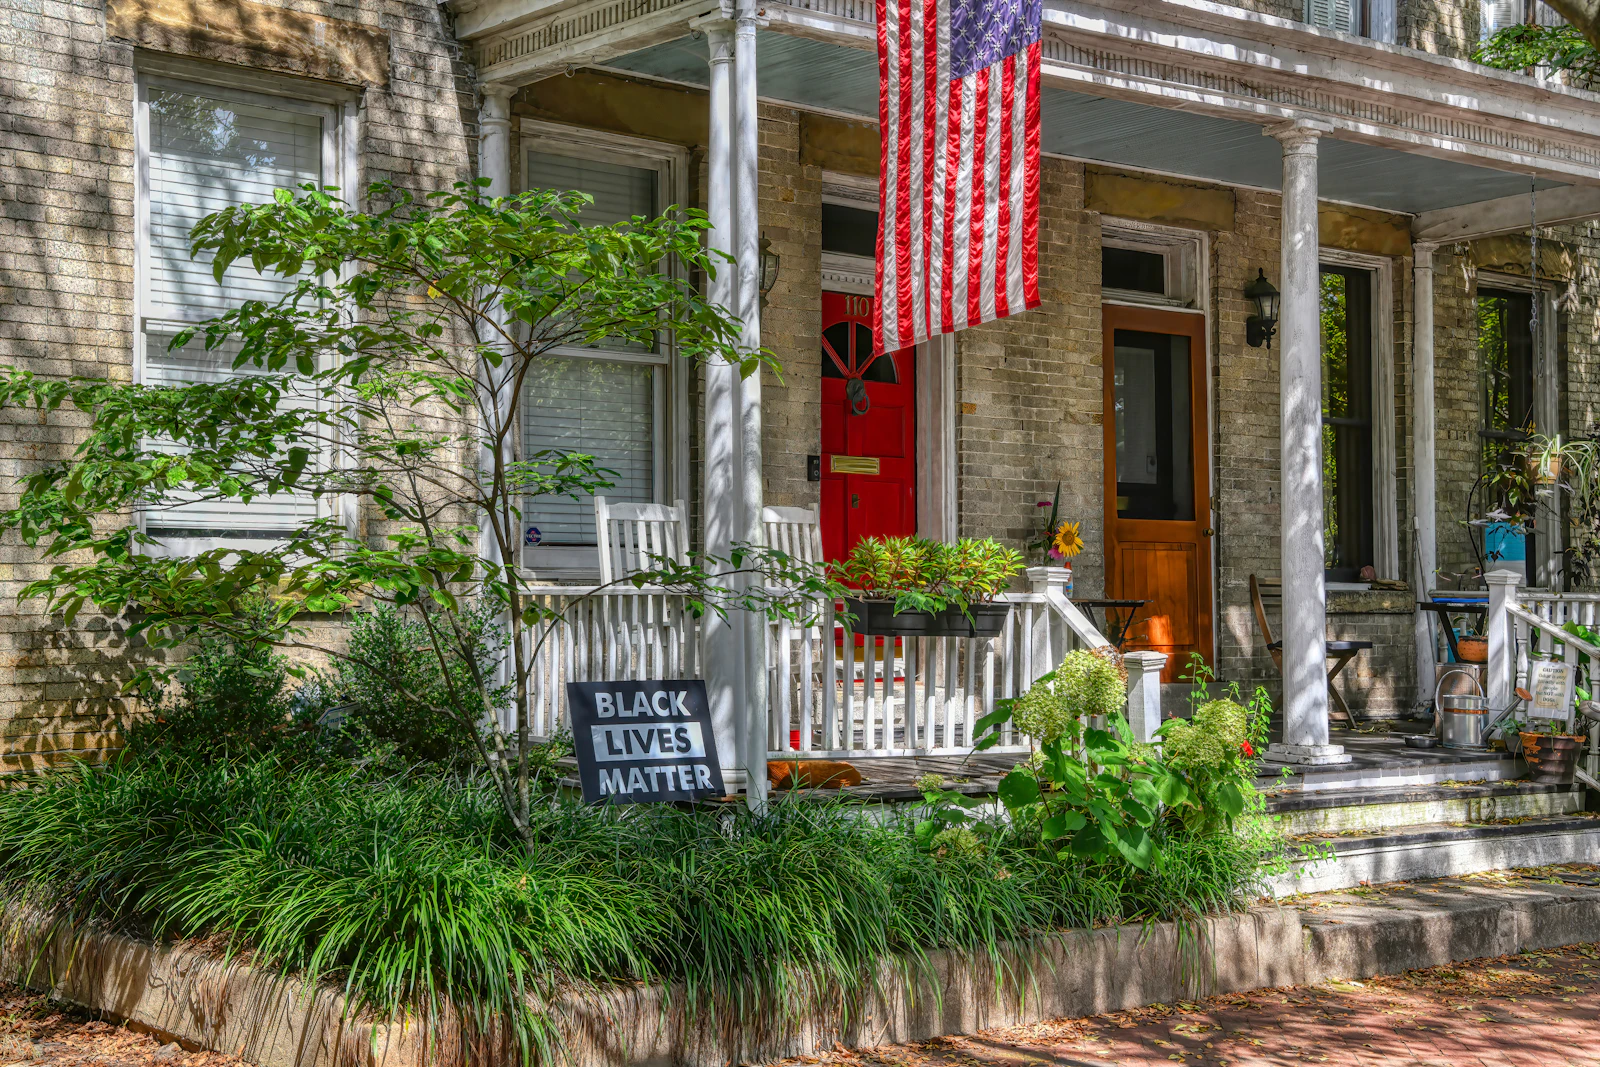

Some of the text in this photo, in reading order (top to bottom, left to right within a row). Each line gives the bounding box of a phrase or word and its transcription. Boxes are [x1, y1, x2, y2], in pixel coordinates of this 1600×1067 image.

[845, 295, 869, 317] 110
[595, 690, 691, 718] BLACK
[605, 728, 691, 755] LIVES
[599, 764, 714, 795] MATTER
[1465, 797, 1496, 821] 112
